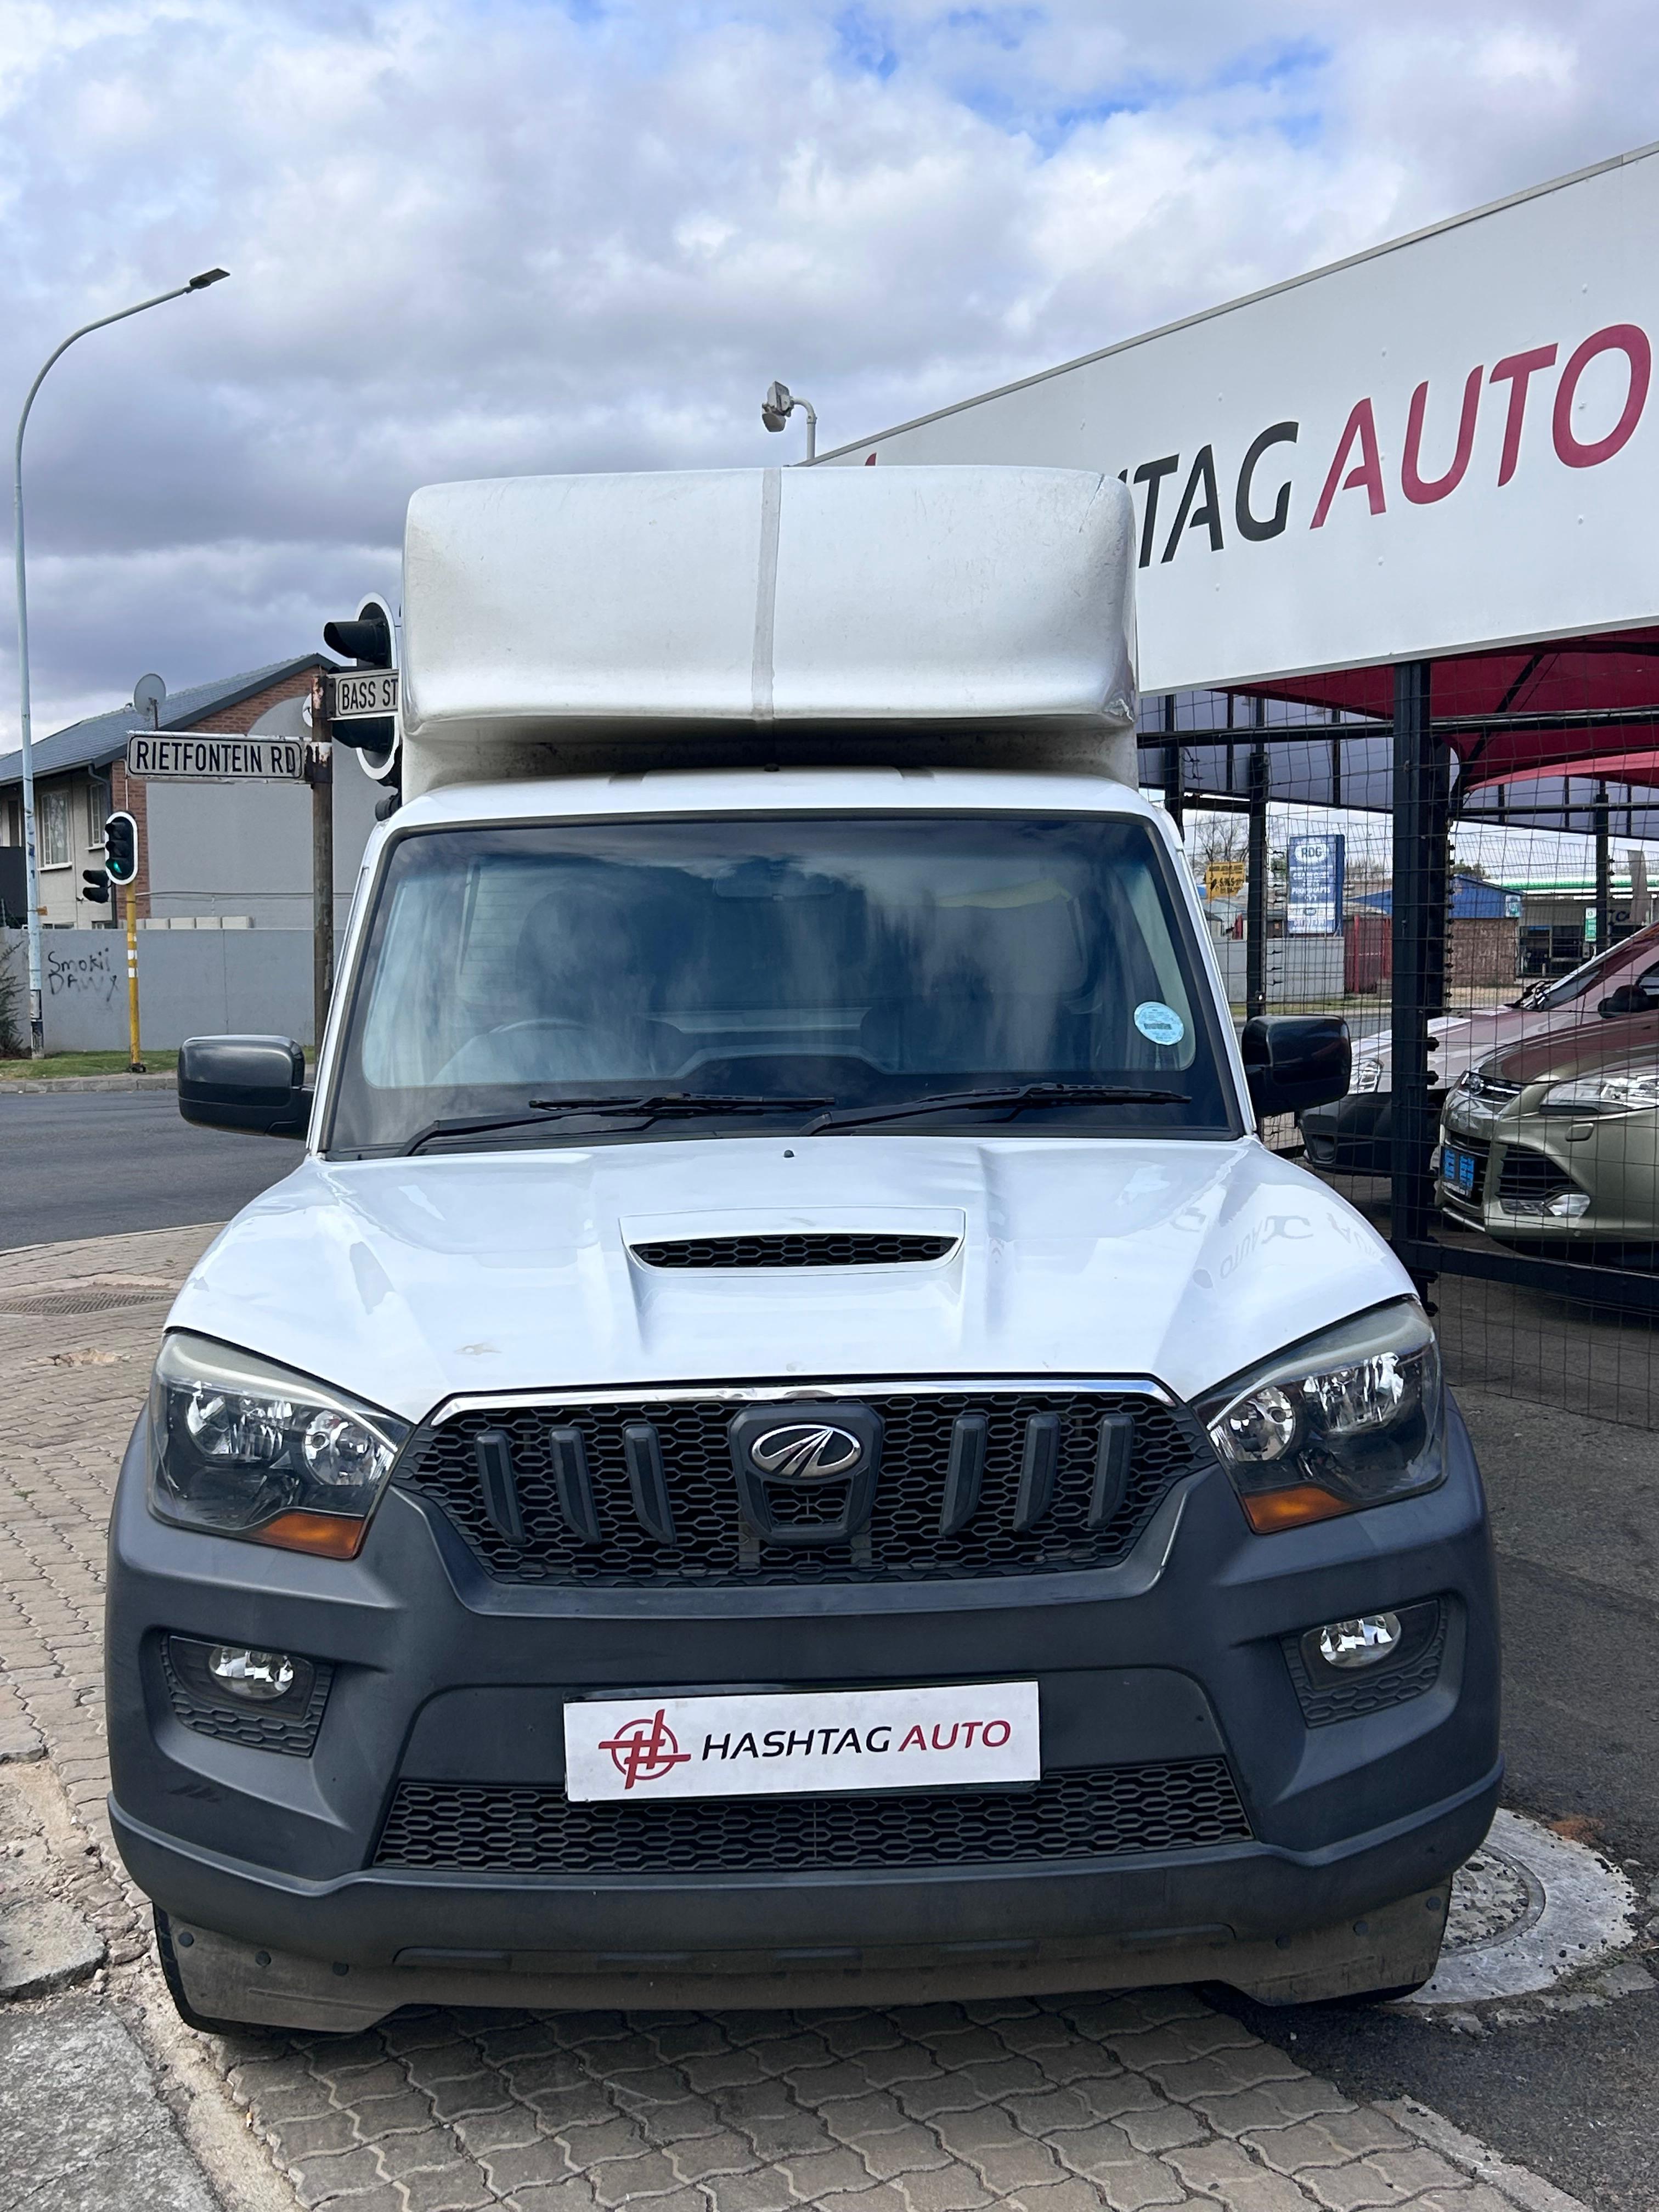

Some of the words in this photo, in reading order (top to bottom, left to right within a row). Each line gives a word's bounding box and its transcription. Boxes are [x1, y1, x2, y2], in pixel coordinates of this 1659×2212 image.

[1118, 421, 1299, 569] TAG
[1310, 324, 1651, 530] AUTO
[342, 681, 376, 710] BASS
[382, 678, 399, 707] ST
[137, 741, 262, 773] RIETFONTEIN
[271, 746, 296, 774] RD
[702, 1726, 892, 1760] HASHTAG
[898, 1720, 1011, 1752] AUTO
